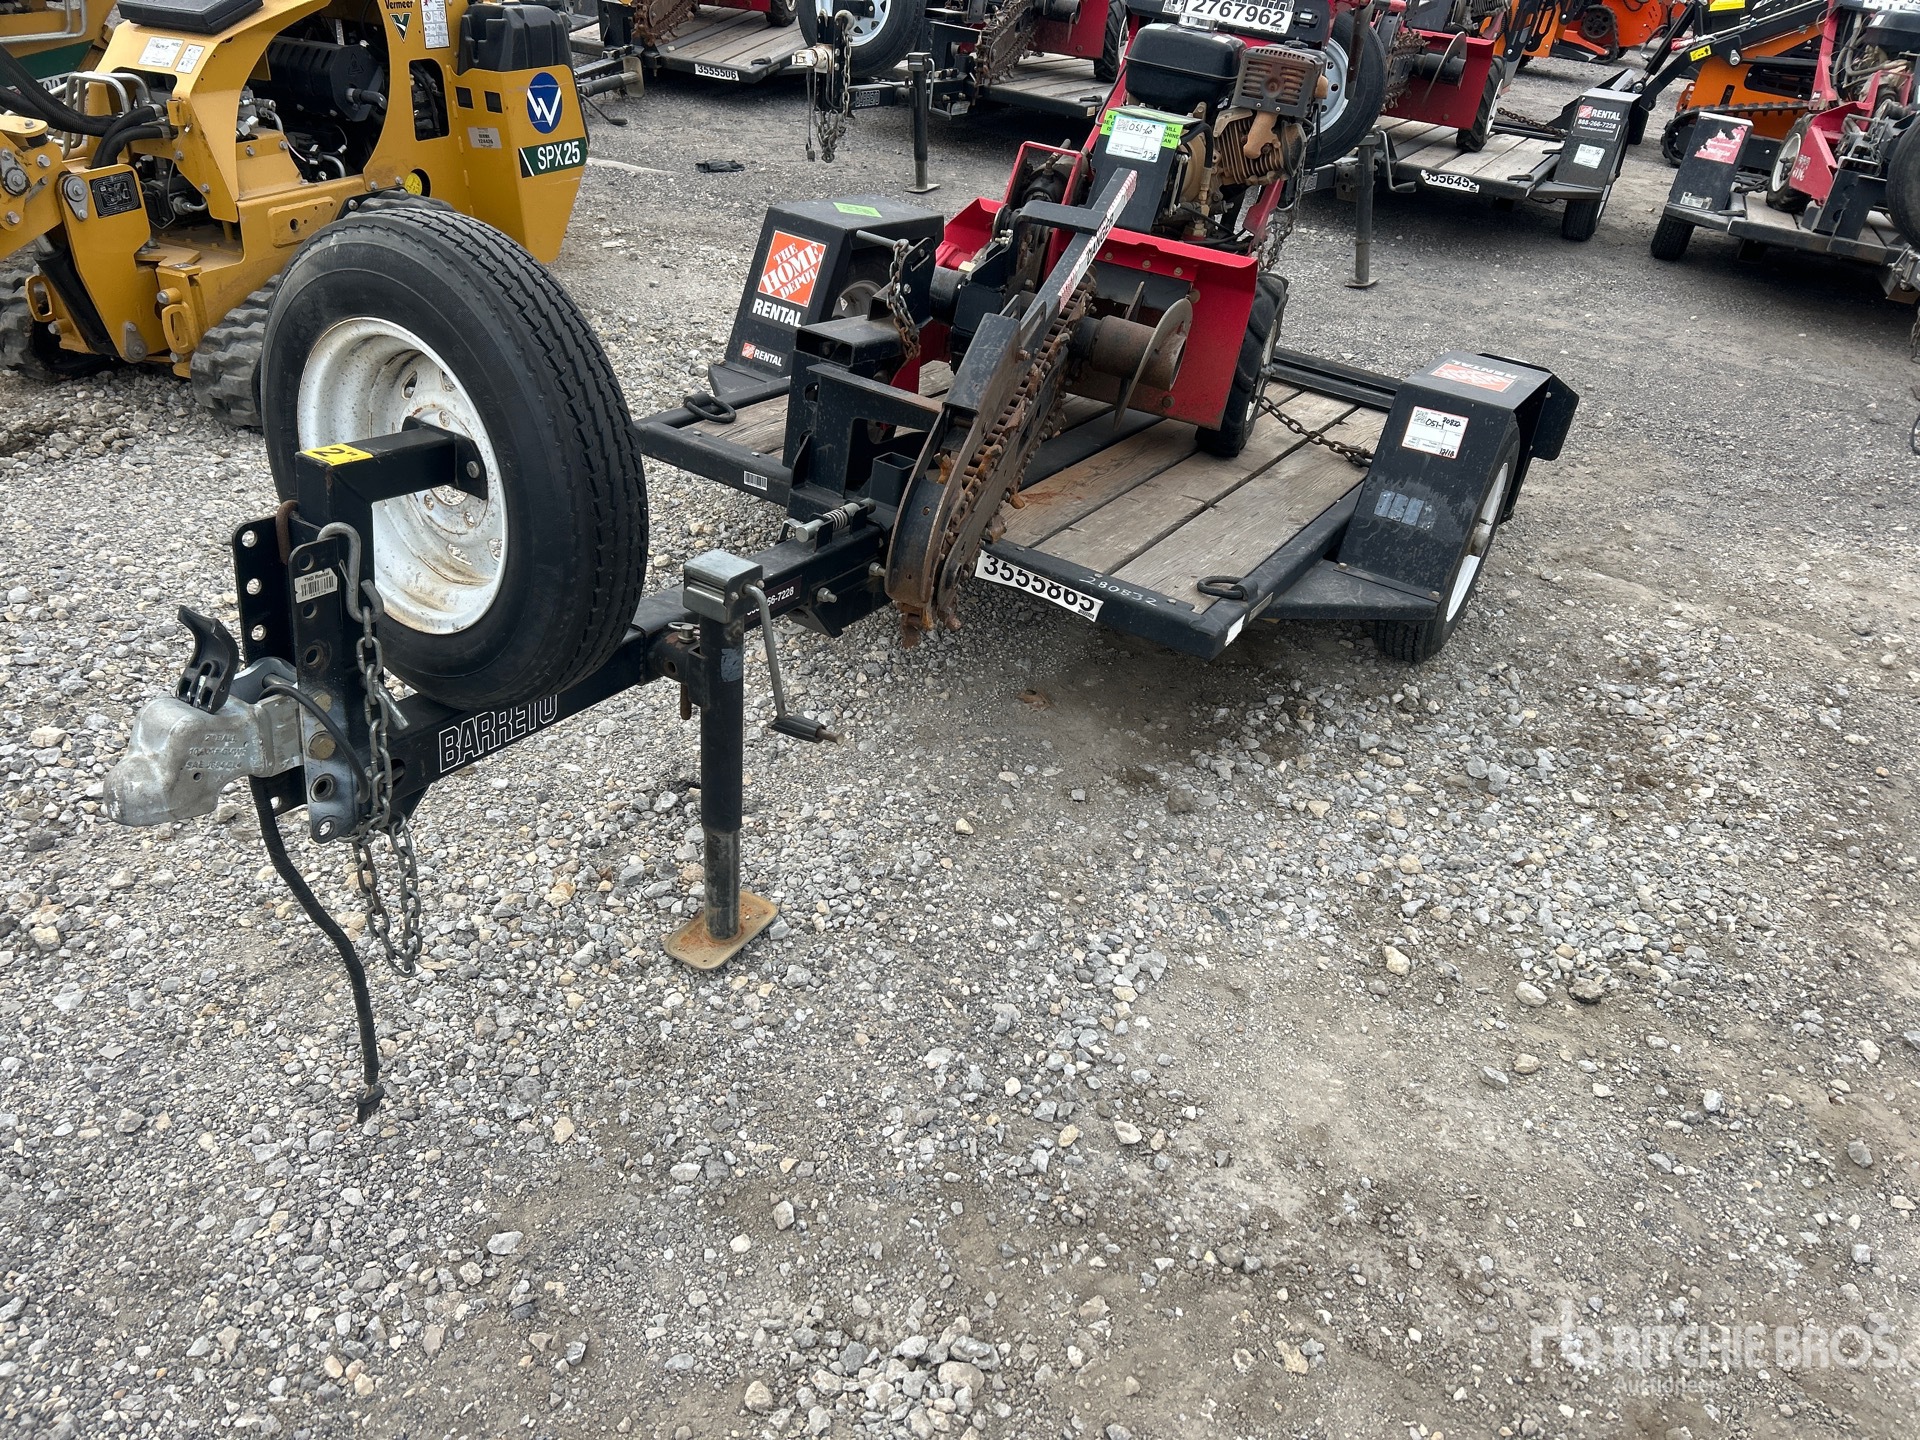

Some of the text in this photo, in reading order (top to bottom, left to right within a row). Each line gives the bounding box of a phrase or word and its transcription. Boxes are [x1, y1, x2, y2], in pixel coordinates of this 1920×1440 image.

[385, 0, 413, 9] Vermeer
[1191, 0, 1286, 27] 2767962
[1591, 108, 1620, 120] RENTAL
[537, 140, 581, 170] SPX25
[773, 243, 799, 265] THE
[761, 242, 823, 294] HOME
[779, 266, 817, 299] DEPOT
[752, 298, 802, 328] RENTAL
[753, 348, 782, 367] RENTAL
